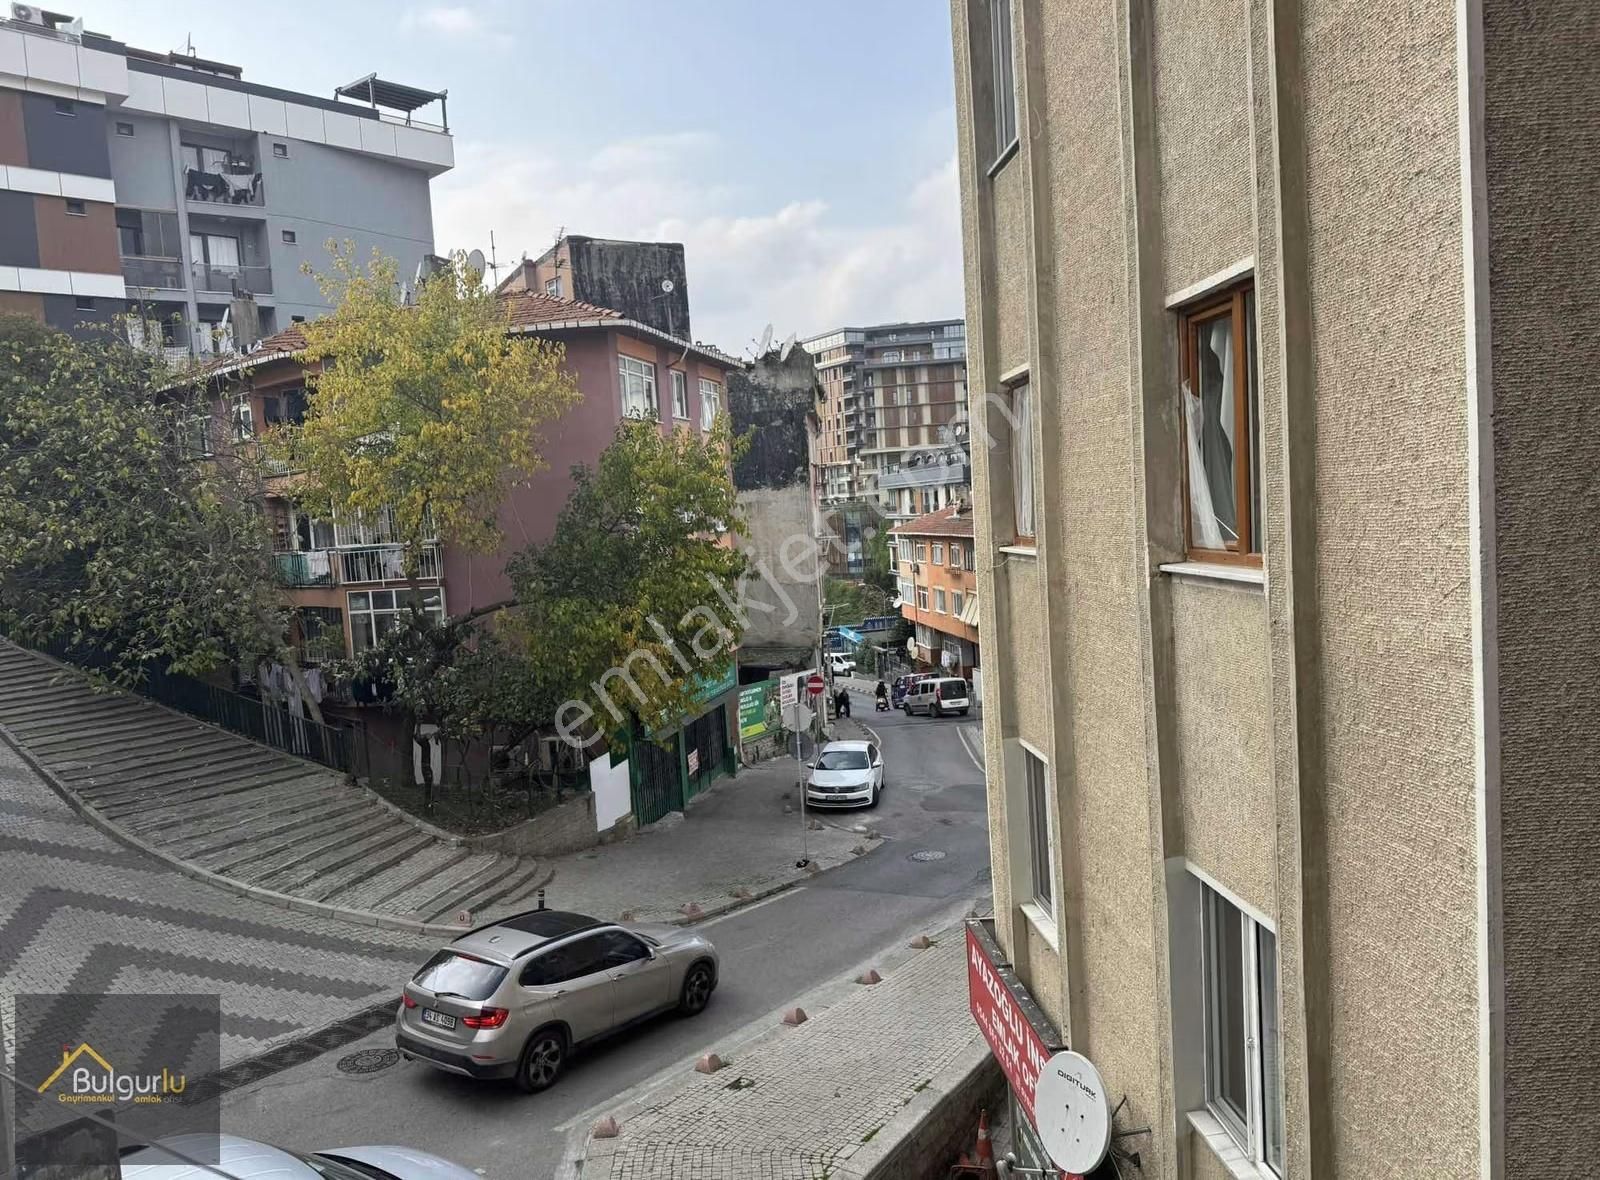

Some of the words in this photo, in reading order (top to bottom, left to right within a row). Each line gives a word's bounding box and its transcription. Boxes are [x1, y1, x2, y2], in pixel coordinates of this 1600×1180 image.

[971, 945, 1023, 1044] AYAZOĞLU
[992, 1008, 1020, 1072] EMLAK
[1022, 1062, 1036, 1092] OF
[1057, 1069, 1096, 1099] DIGITURK
